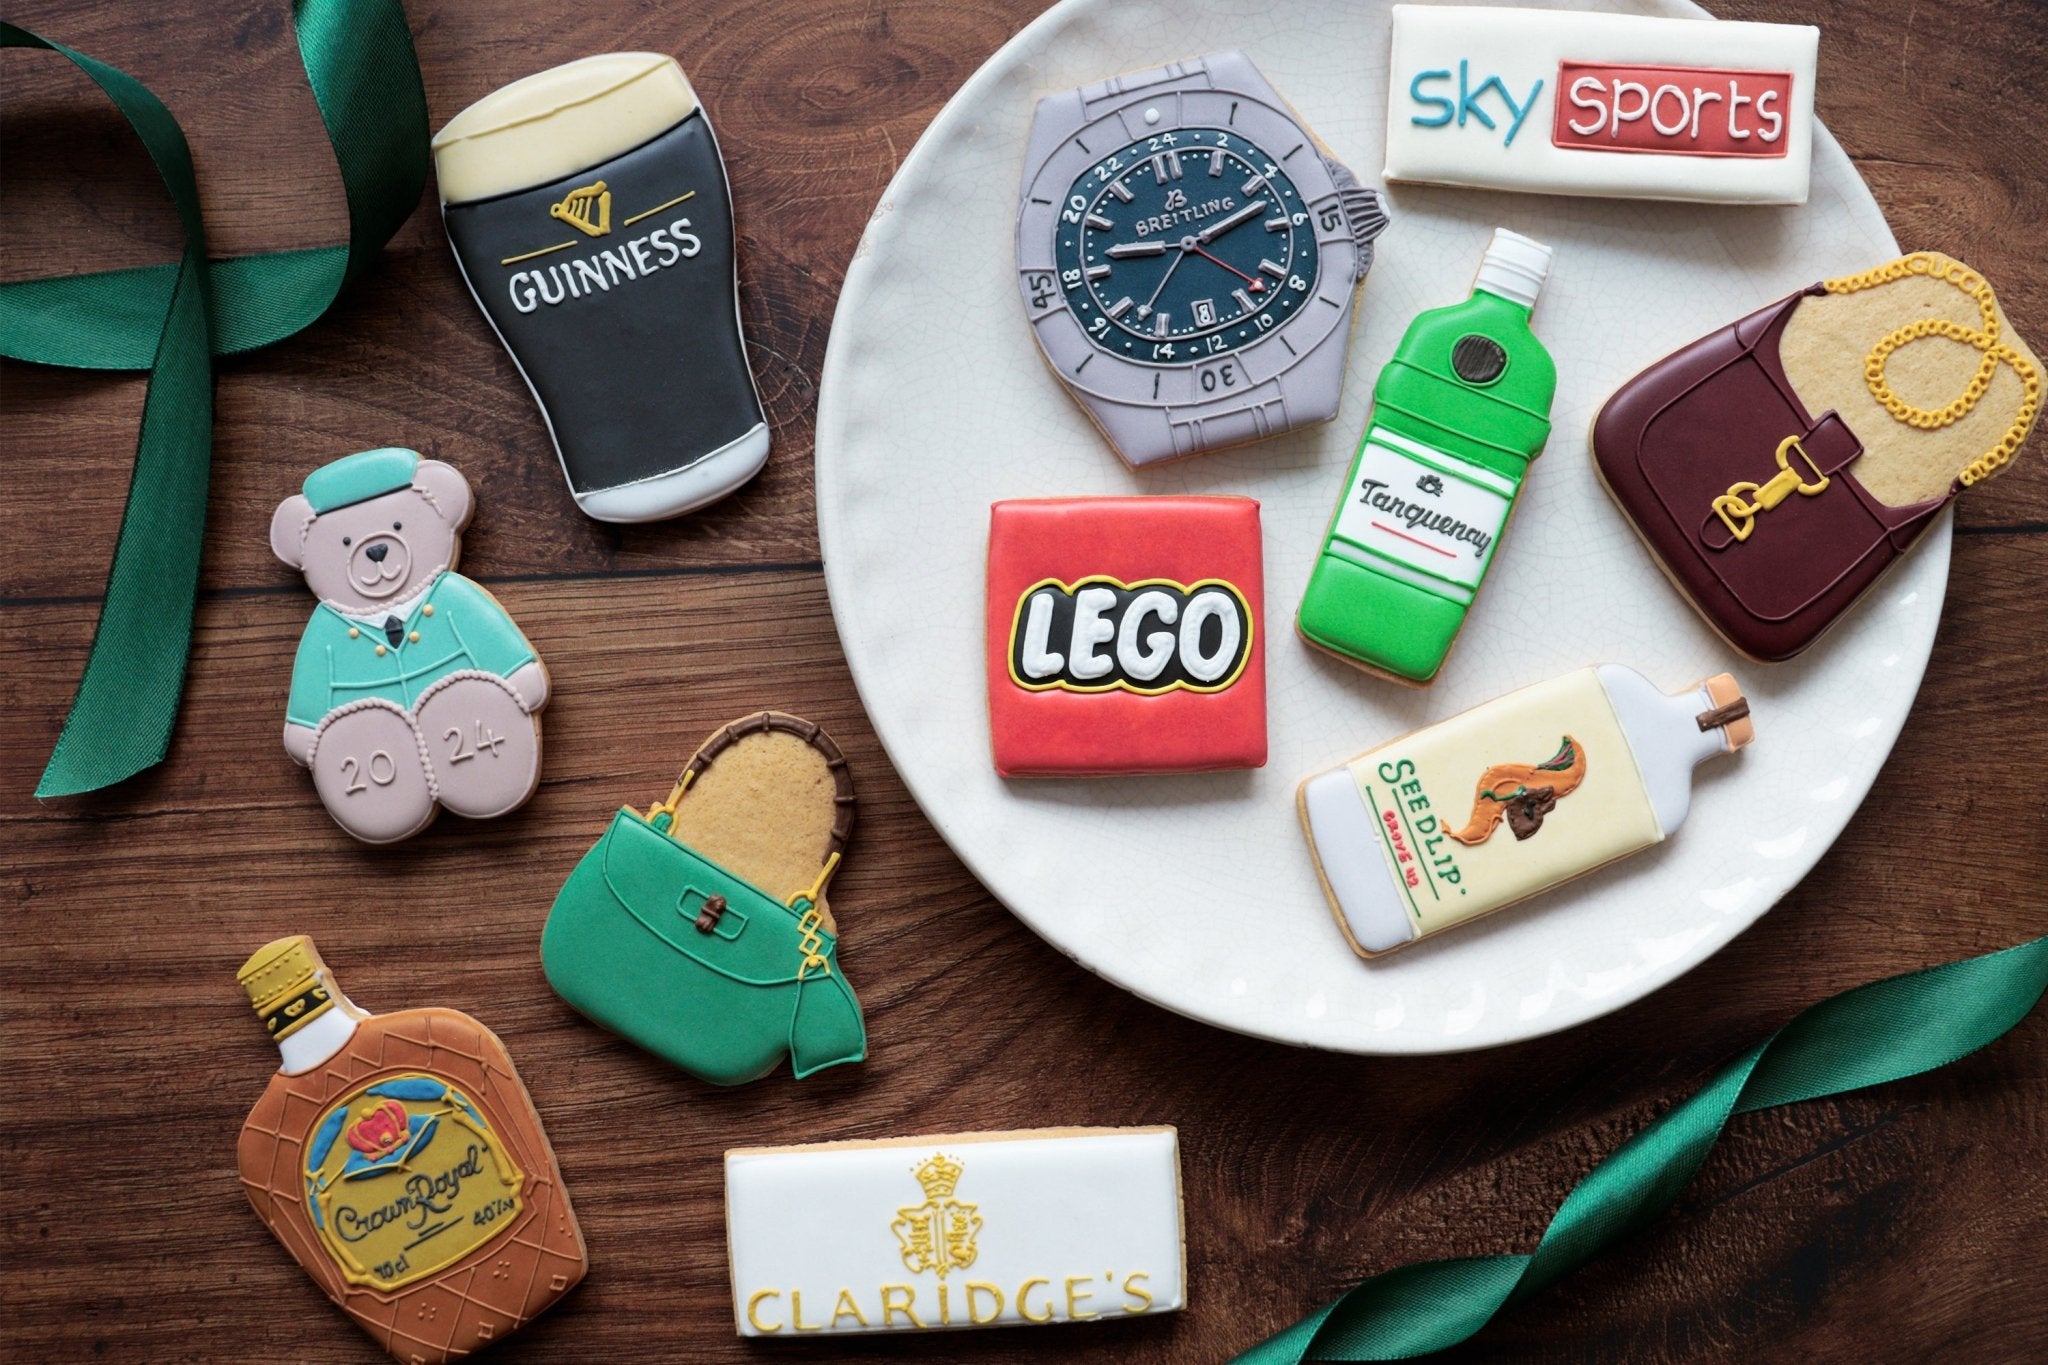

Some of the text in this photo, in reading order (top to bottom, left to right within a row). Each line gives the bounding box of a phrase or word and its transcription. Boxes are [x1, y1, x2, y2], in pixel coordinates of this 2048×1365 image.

[1410, 57, 1783, 147] sky sports
[1148, 132, 1178, 152] 24
[1216, 132, 1229, 148] 2
[1094, 157, 1124, 182] 22
[1062, 194, 1087, 225] 20
[1135, 196, 1236, 238] BREITLING
[1292, 212, 1309, 227] 6
[1318, 203, 1342, 232] 15
[509, 217, 702, 314] GUINNESS
[1062, 268, 1083, 290] 18
[1028, 273, 1057, 309] 45
[1288, 274, 1307, 291] 8
[1088, 317, 1112, 340] 16
[1254, 313, 1274, 332] 10
[1152, 343, 1176, 360] 14
[1206, 335, 1228, 354] 12
[1201, 363, 1236, 392] 30
[1022, 588, 1241, 682] LEGO
[340, 720, 505, 795] 20 24
[1383, 810, 1413, 864] GROVE
[335, 1198, 415, 1243] Crown
[747, 1270, 1155, 1332] CLARIDGE'S
